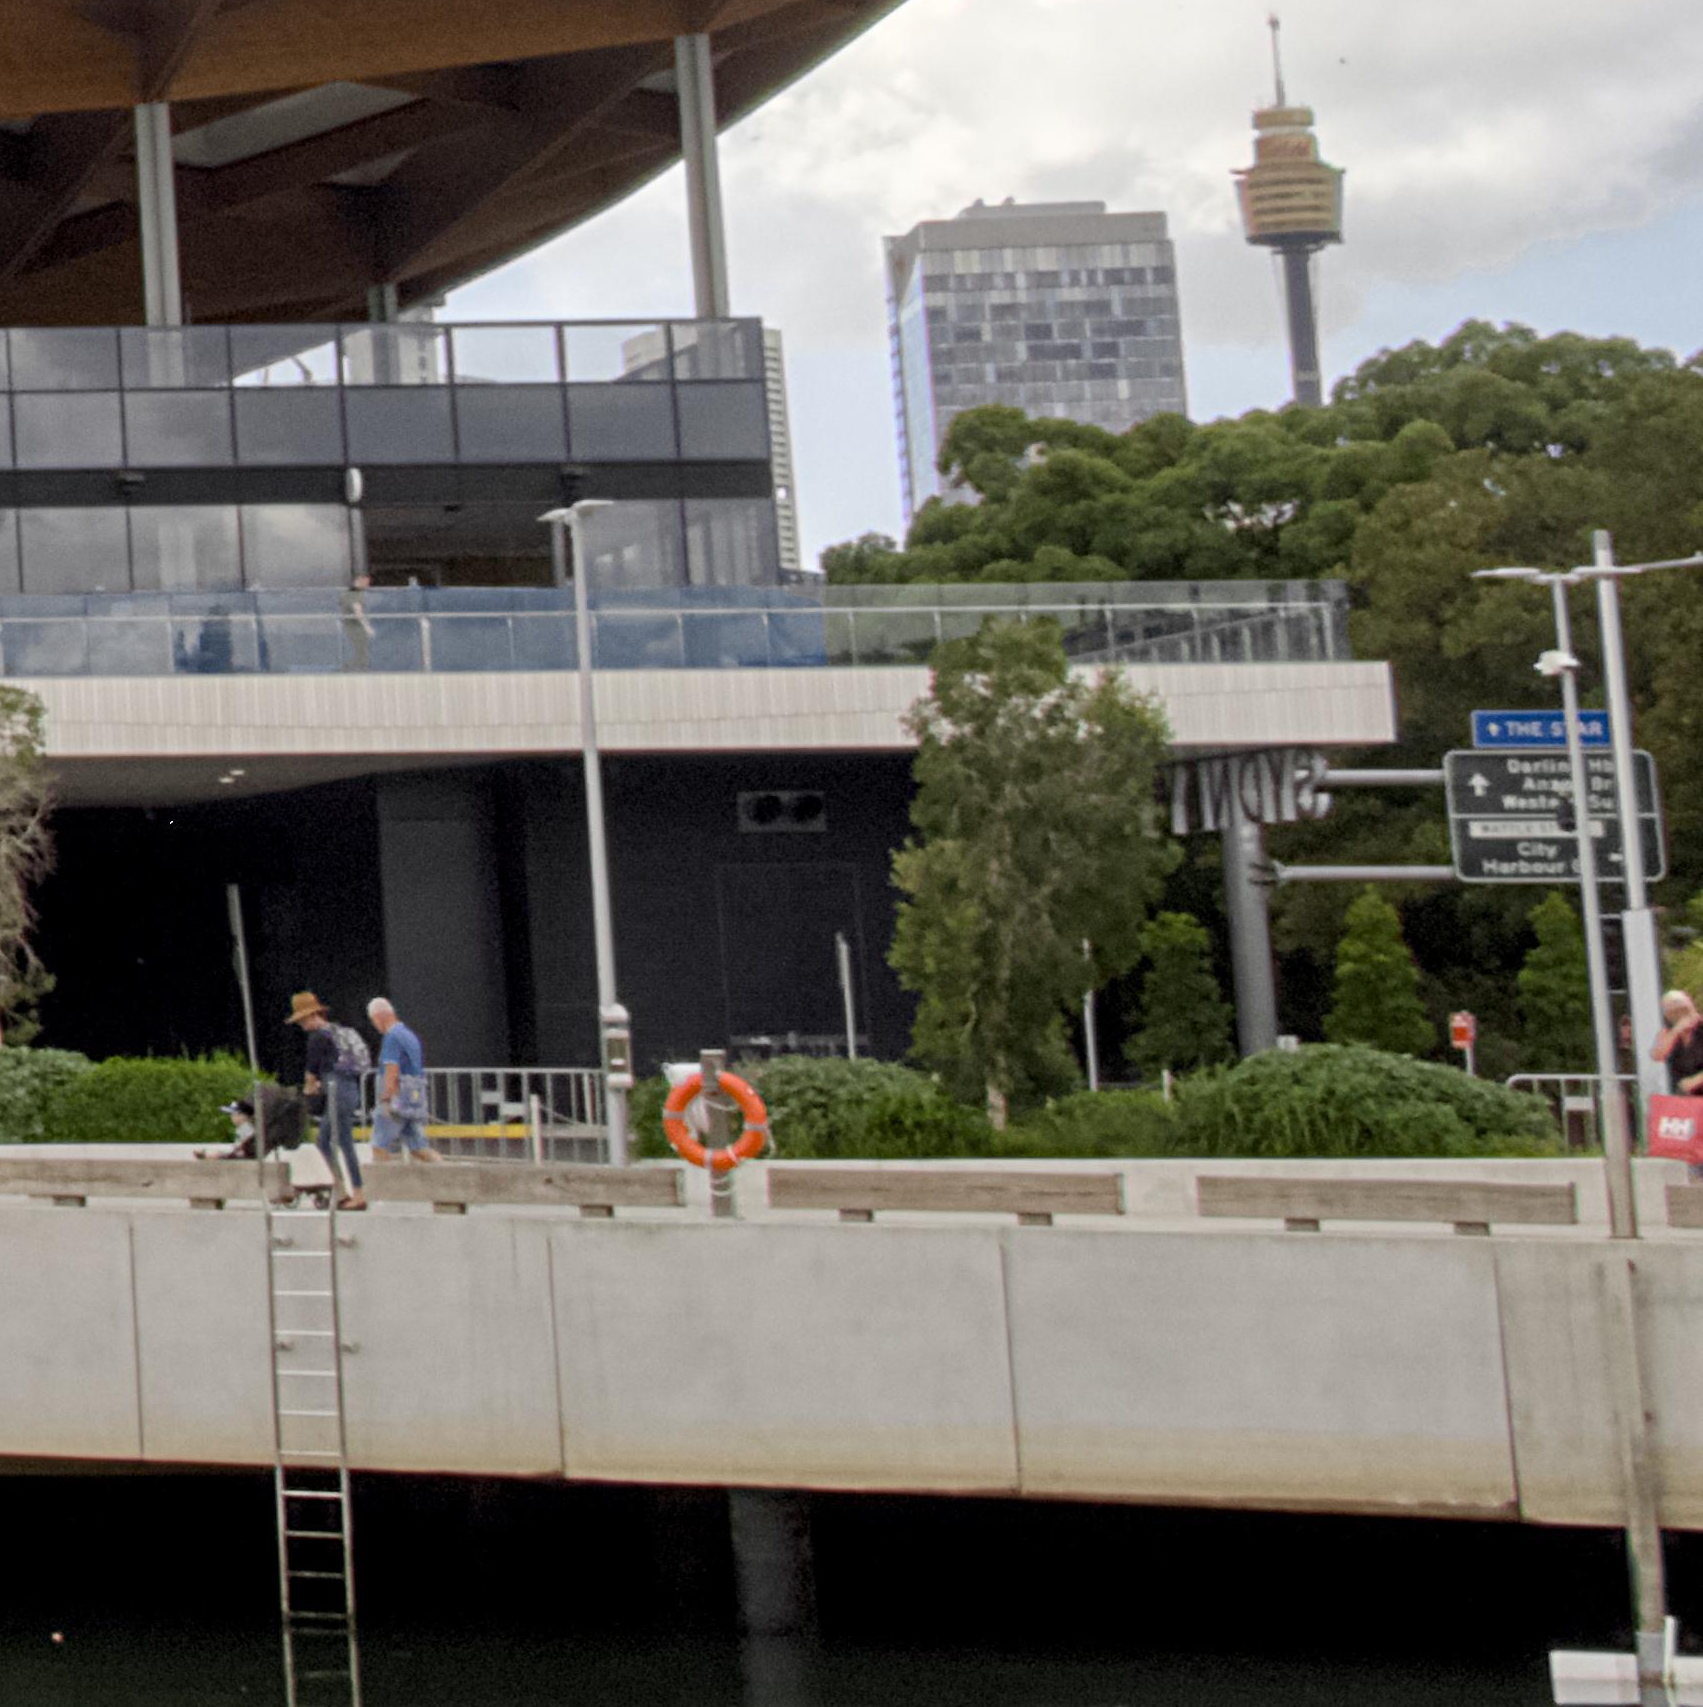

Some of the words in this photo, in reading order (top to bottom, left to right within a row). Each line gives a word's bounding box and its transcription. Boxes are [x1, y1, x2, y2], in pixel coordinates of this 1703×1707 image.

[1504, 720, 1543, 738] THE
[1550, 720, 1604, 738] SAR
[1506, 758, 1575, 775] Darlin
[1587, 758, 1617, 774] Hb
[1521, 776, 1574, 793] Anza
[1501, 794, 1574, 810] Weste
[1588, 794, 1617, 810] Su
[1516, 841, 1559, 859] City
[1481, 859, 1566, 875] Harbour
[1658, 1116, 1695, 1141] HH
